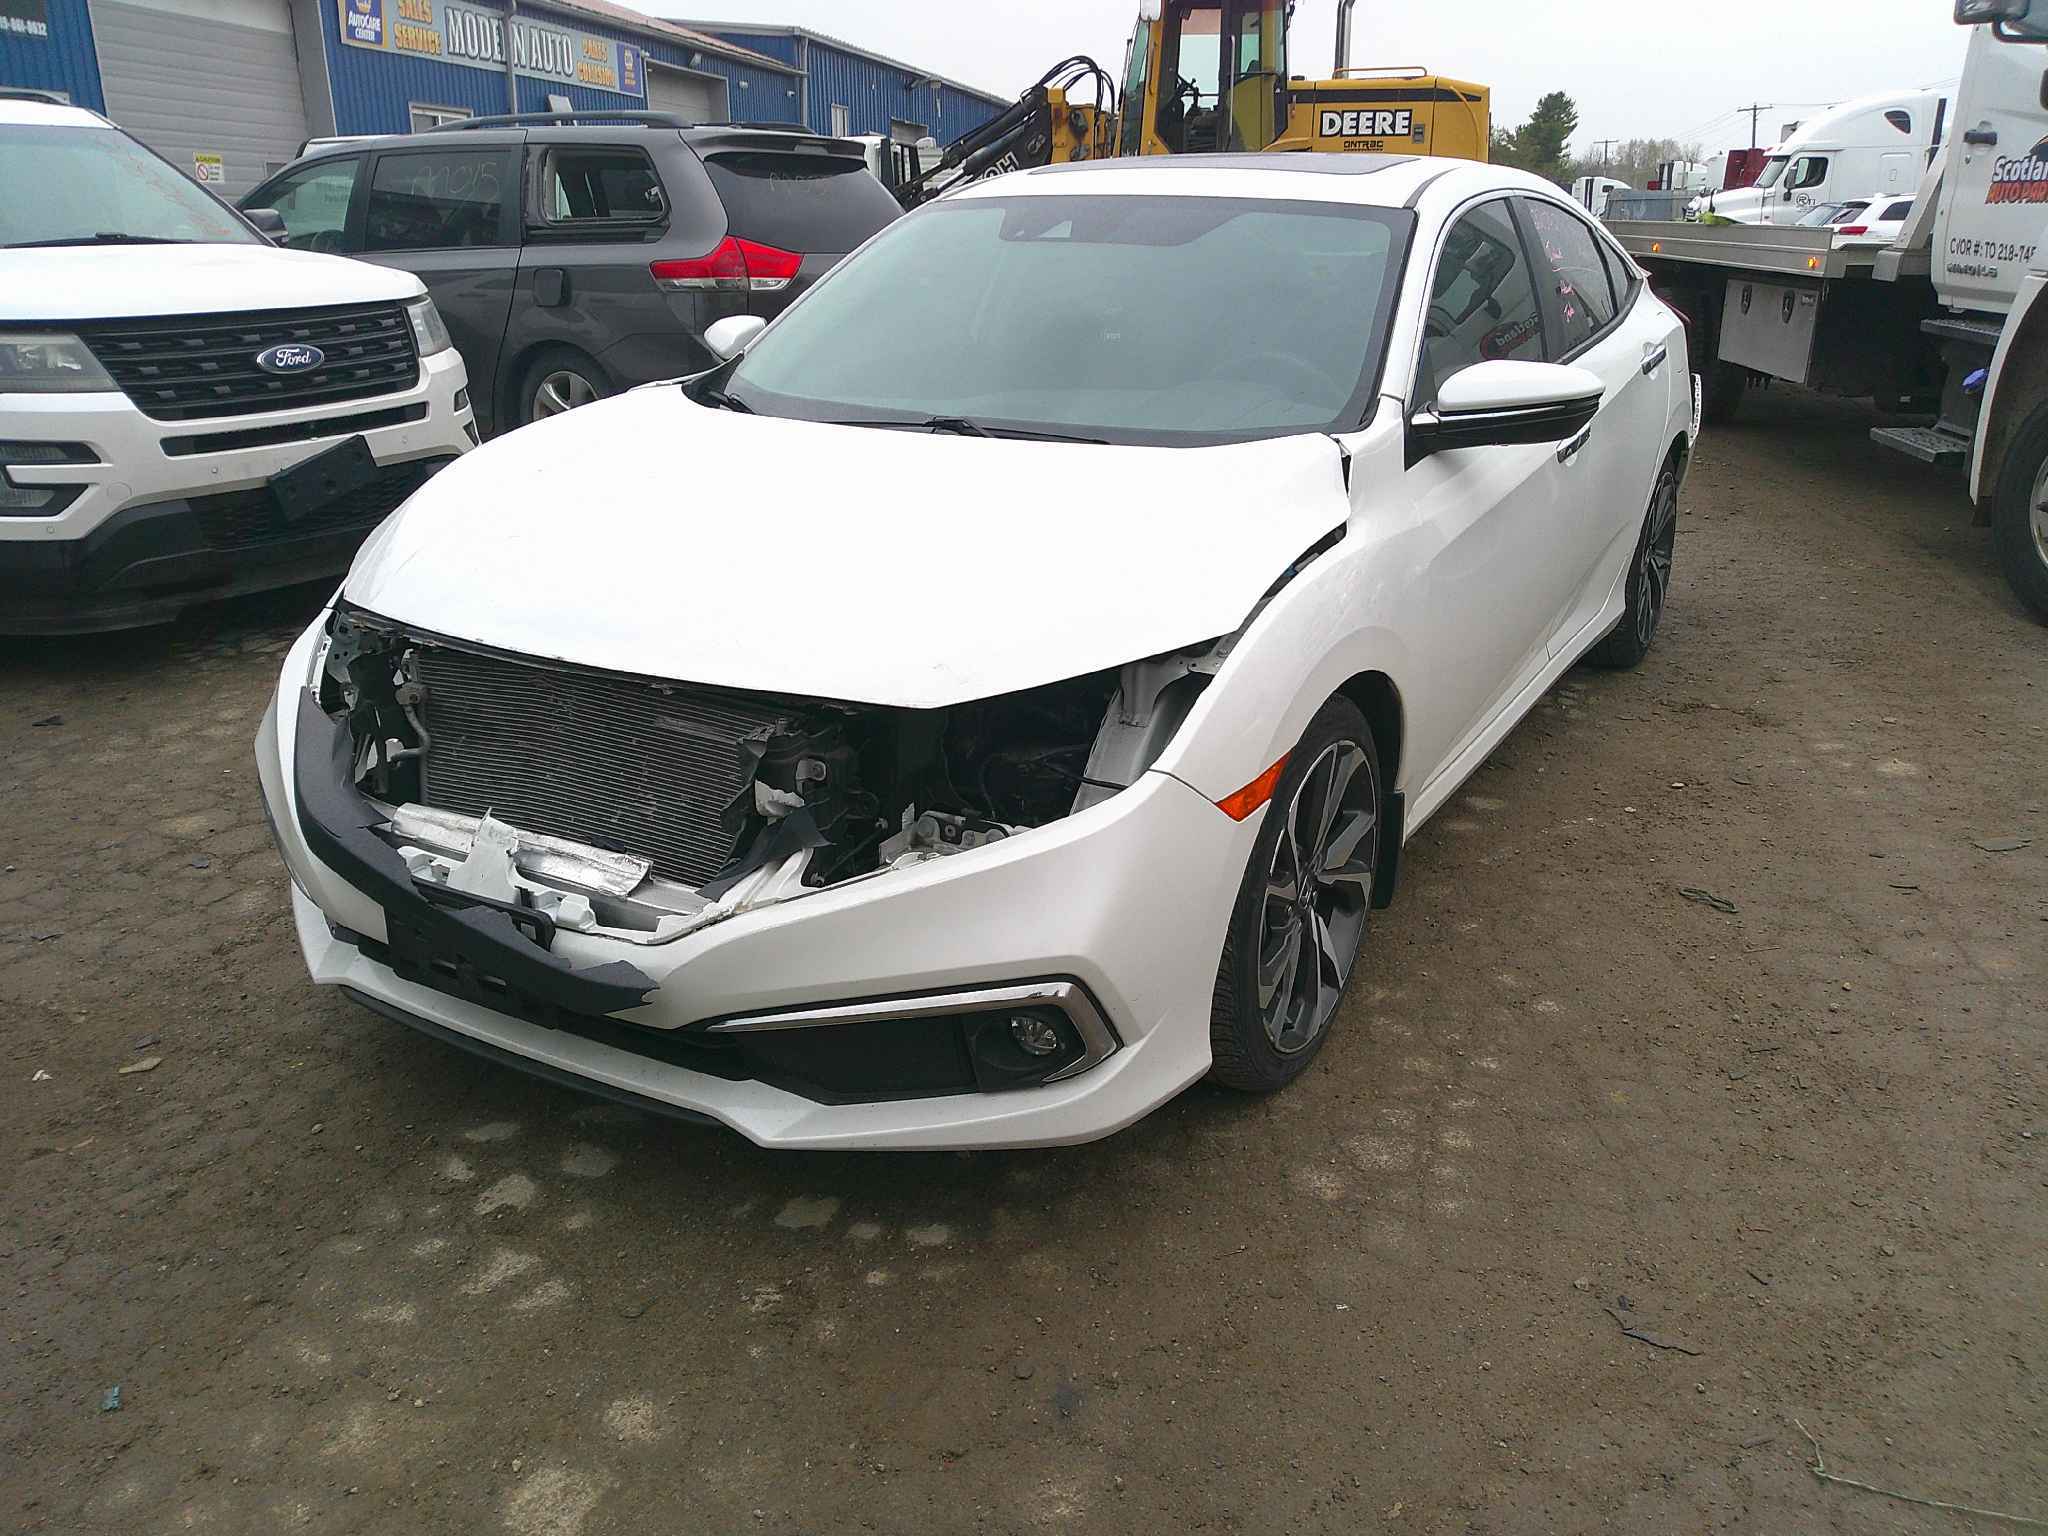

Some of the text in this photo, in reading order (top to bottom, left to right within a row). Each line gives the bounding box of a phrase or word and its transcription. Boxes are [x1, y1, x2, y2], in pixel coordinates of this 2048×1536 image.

[355, 27, 376, 41] CENTER
[394, 22, 442, 55] SERVICE
[529, 26, 573, 77] AUTO
[1320, 109, 1412, 137] DEERE
[1985, 242, 1996, 259] TO
[276, 348, 311, 367] Ford
